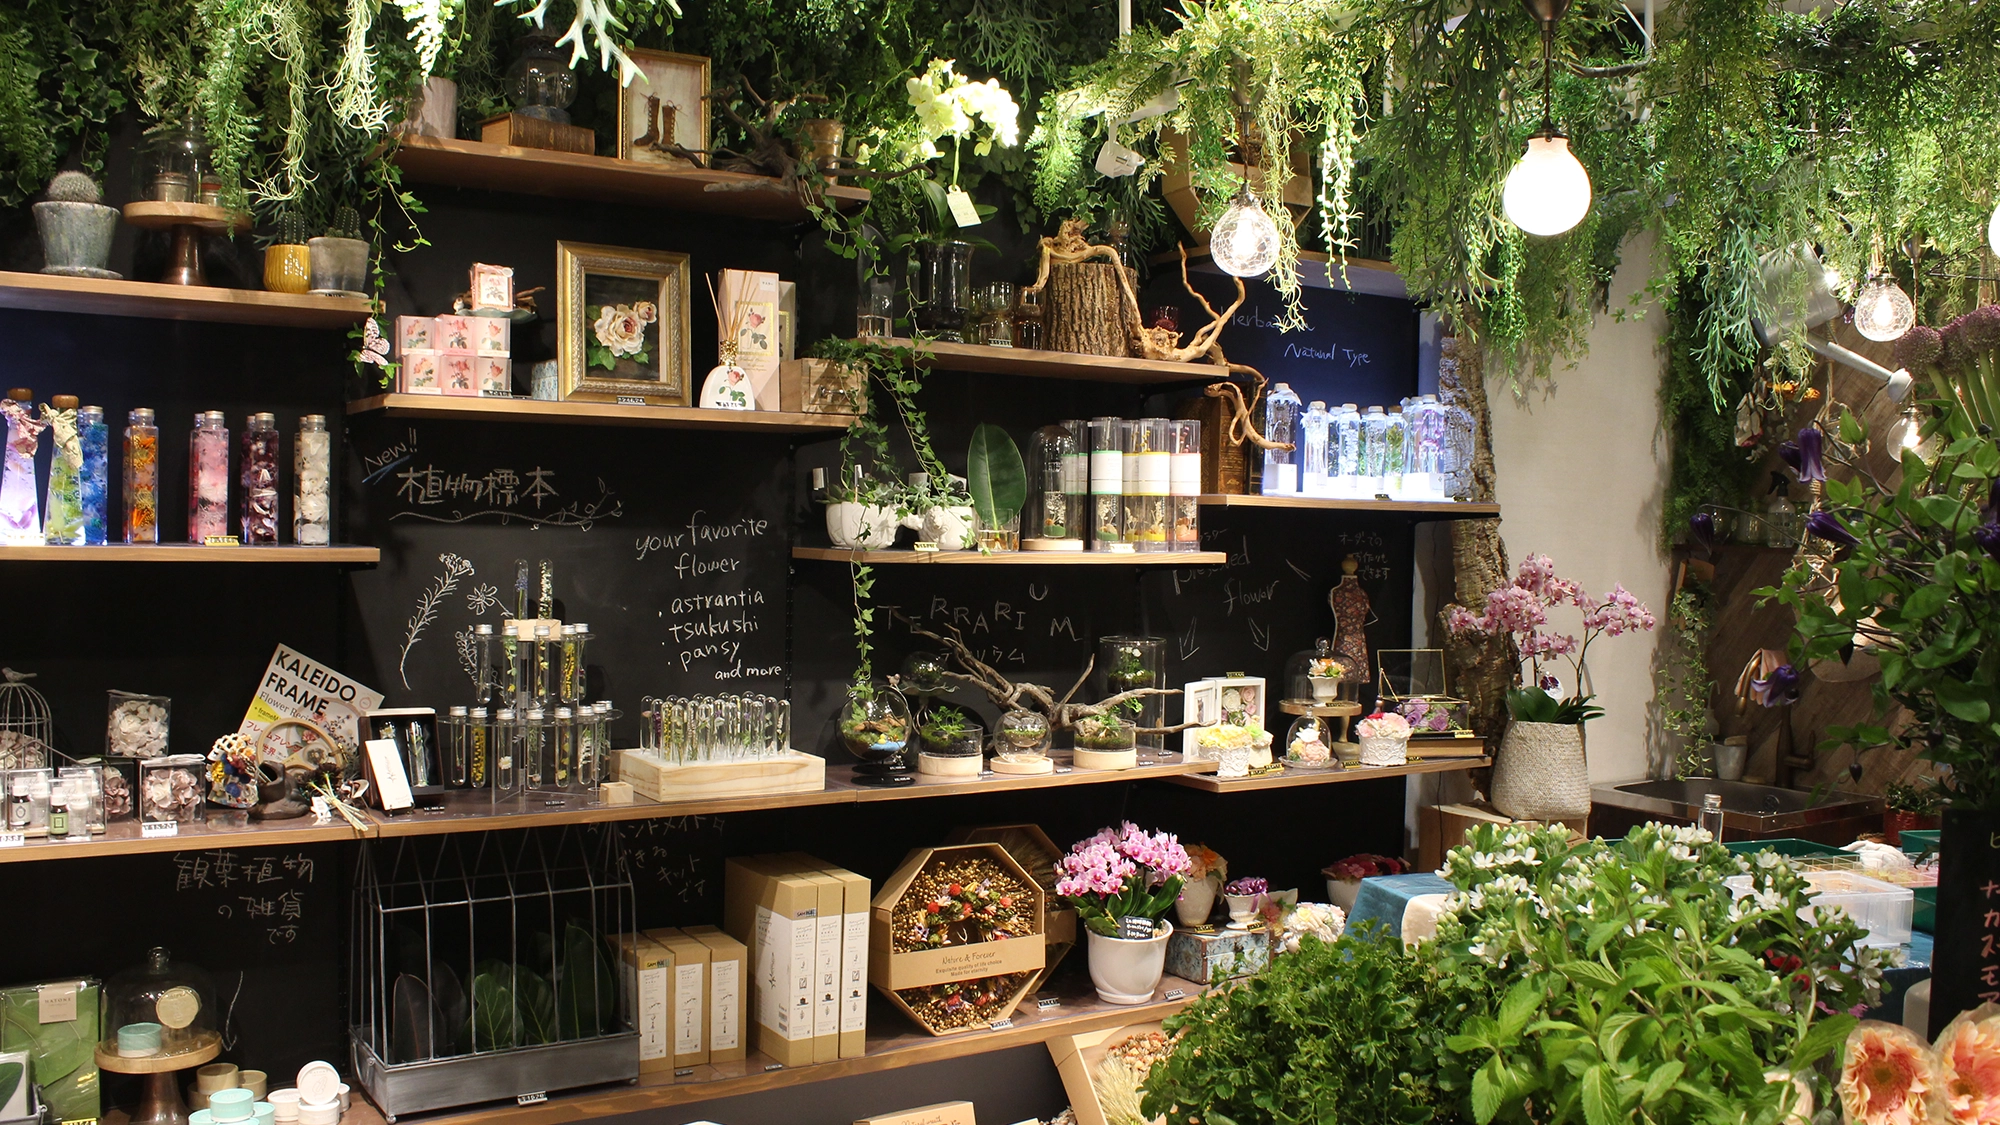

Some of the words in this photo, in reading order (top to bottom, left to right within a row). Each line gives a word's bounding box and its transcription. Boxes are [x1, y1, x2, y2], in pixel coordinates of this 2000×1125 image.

[1342, 347, 1371, 368] Type
[396, 463, 560, 510] 植物標本
[635, 533, 684, 561] your
[686, 509, 768, 546] favorite
[674, 551, 740, 580] flower
[671, 587, 765, 614] astrantia
[668, 610, 759, 643] tsukushi
[680, 641, 740, 672] pansy
[714, 659, 742, 680] and
[746, 663, 782, 677] more
[275, 650, 356, 702] KALEIDO
[259, 691, 289, 713] Flower
[265, 672, 329, 716] FRAME
[173, 849, 314, 892] 観葉植物
[217, 889, 304, 921] の雑貨
[266, 924, 300, 945] です
[942, 955, 963, 965] Nature
[972, 951, 996, 961] Forever
